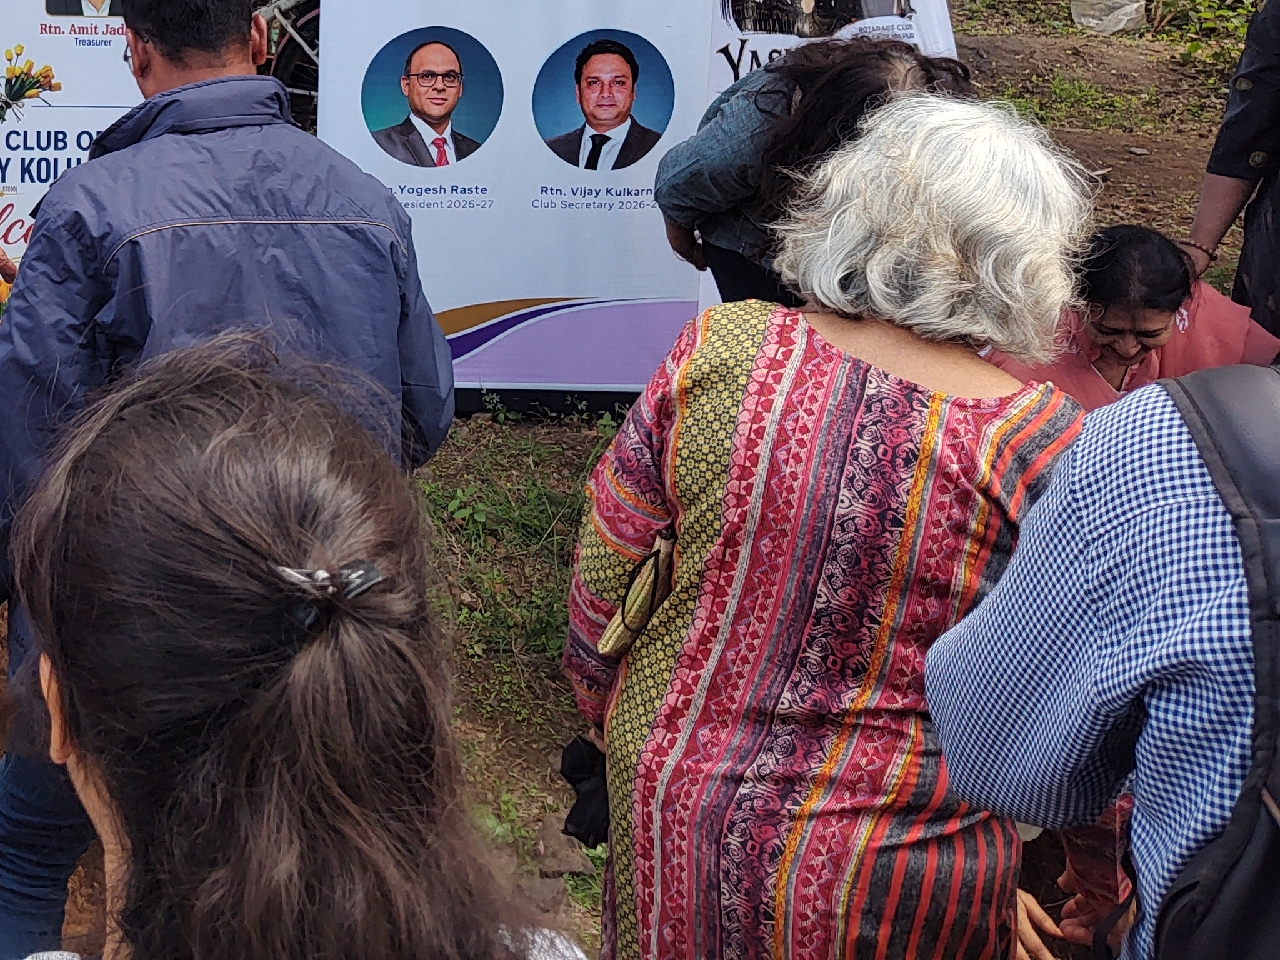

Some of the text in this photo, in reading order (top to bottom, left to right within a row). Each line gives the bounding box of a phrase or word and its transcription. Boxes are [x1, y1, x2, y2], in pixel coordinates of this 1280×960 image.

[39, 23, 126, 36] Rtn. Amit Jad
[74, 38, 113, 47] Treasurer
[5, 130, 68, 152] CLUB
[451, 185, 488, 196] Raste
[540, 186, 653, 198] Rtn. Vijay Kulkarn
[446, 200, 494, 210] 2026-27
[531, 199, 660, 211] Club Secretary 2026-2
